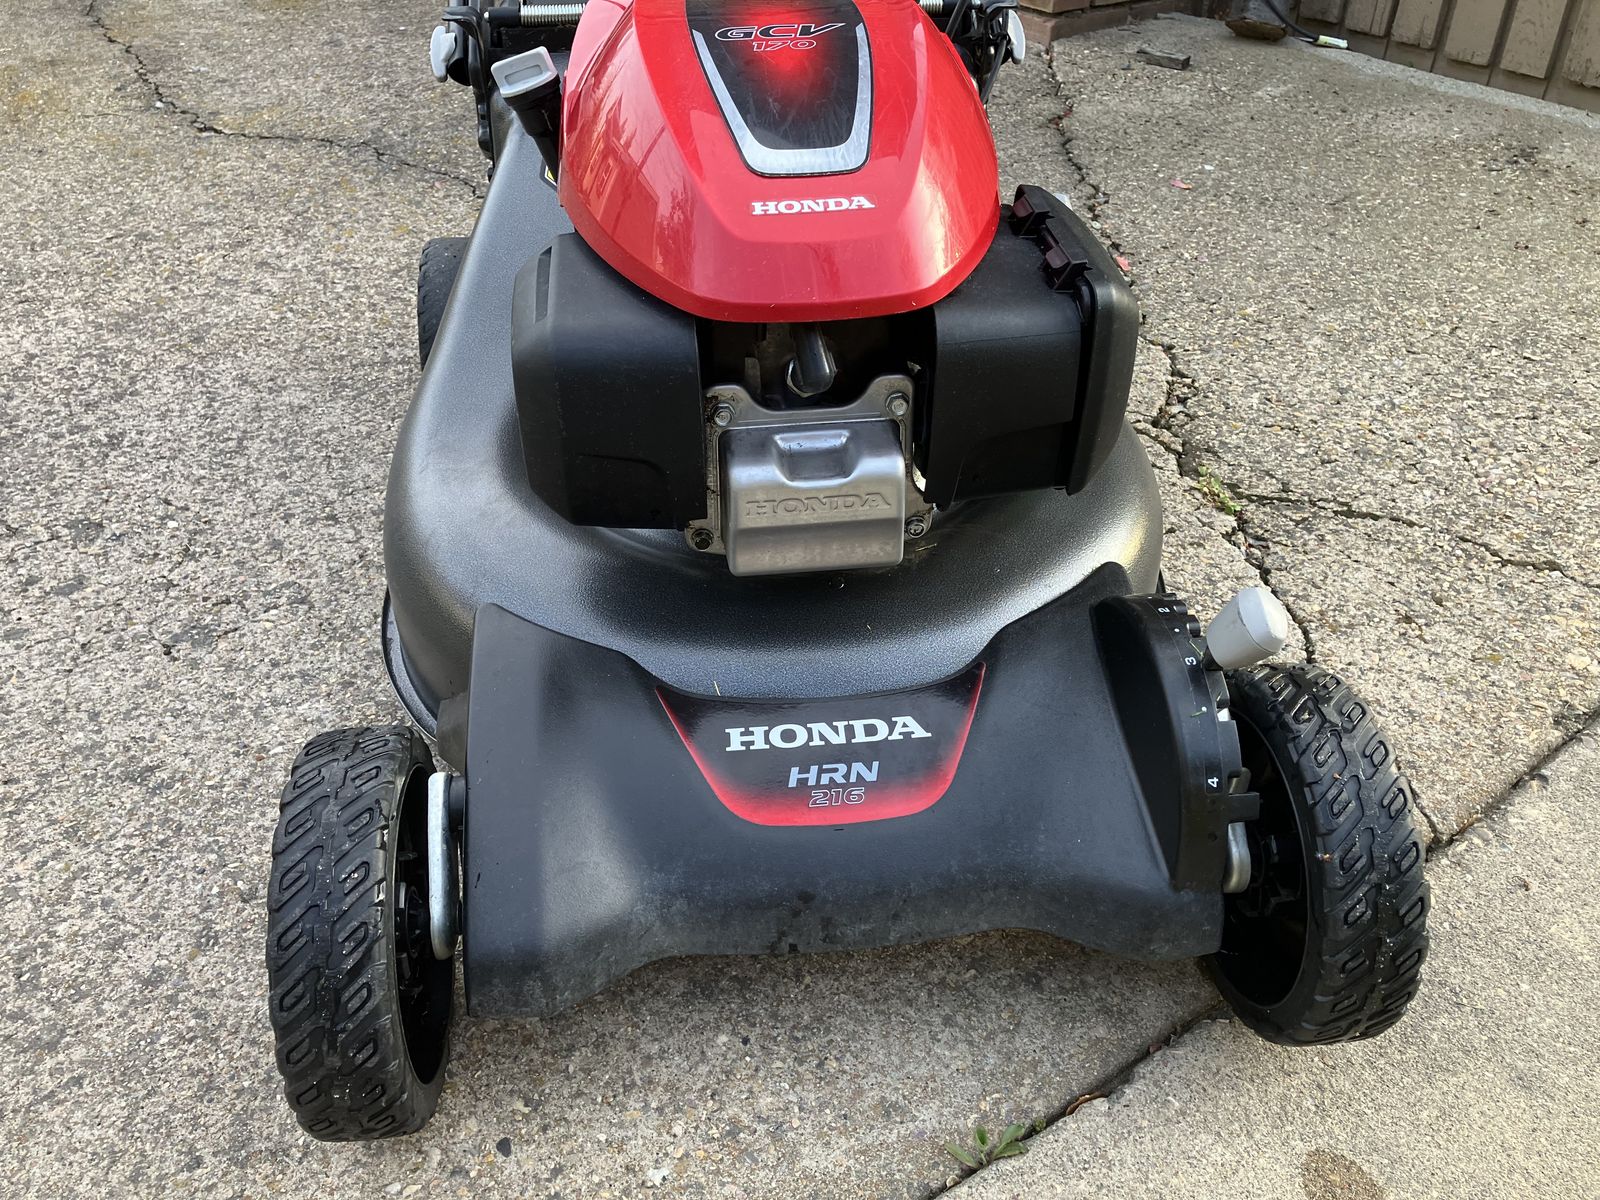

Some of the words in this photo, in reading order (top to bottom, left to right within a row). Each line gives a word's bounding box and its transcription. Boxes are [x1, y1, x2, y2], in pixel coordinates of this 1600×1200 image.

[715, 23, 846, 41] GCV
[753, 39, 817, 52] 170
[752, 196, 876, 215] HONDA
[745, 492, 892, 518] HONDA
[1157, 606, 1171, 614] 2
[1185, 655, 1197, 666] 3
[725, 715, 932, 752] HONDA
[787, 760, 880, 788] HRN
[1207, 776, 1220, 788] 4
[808, 787, 866, 808] 216
